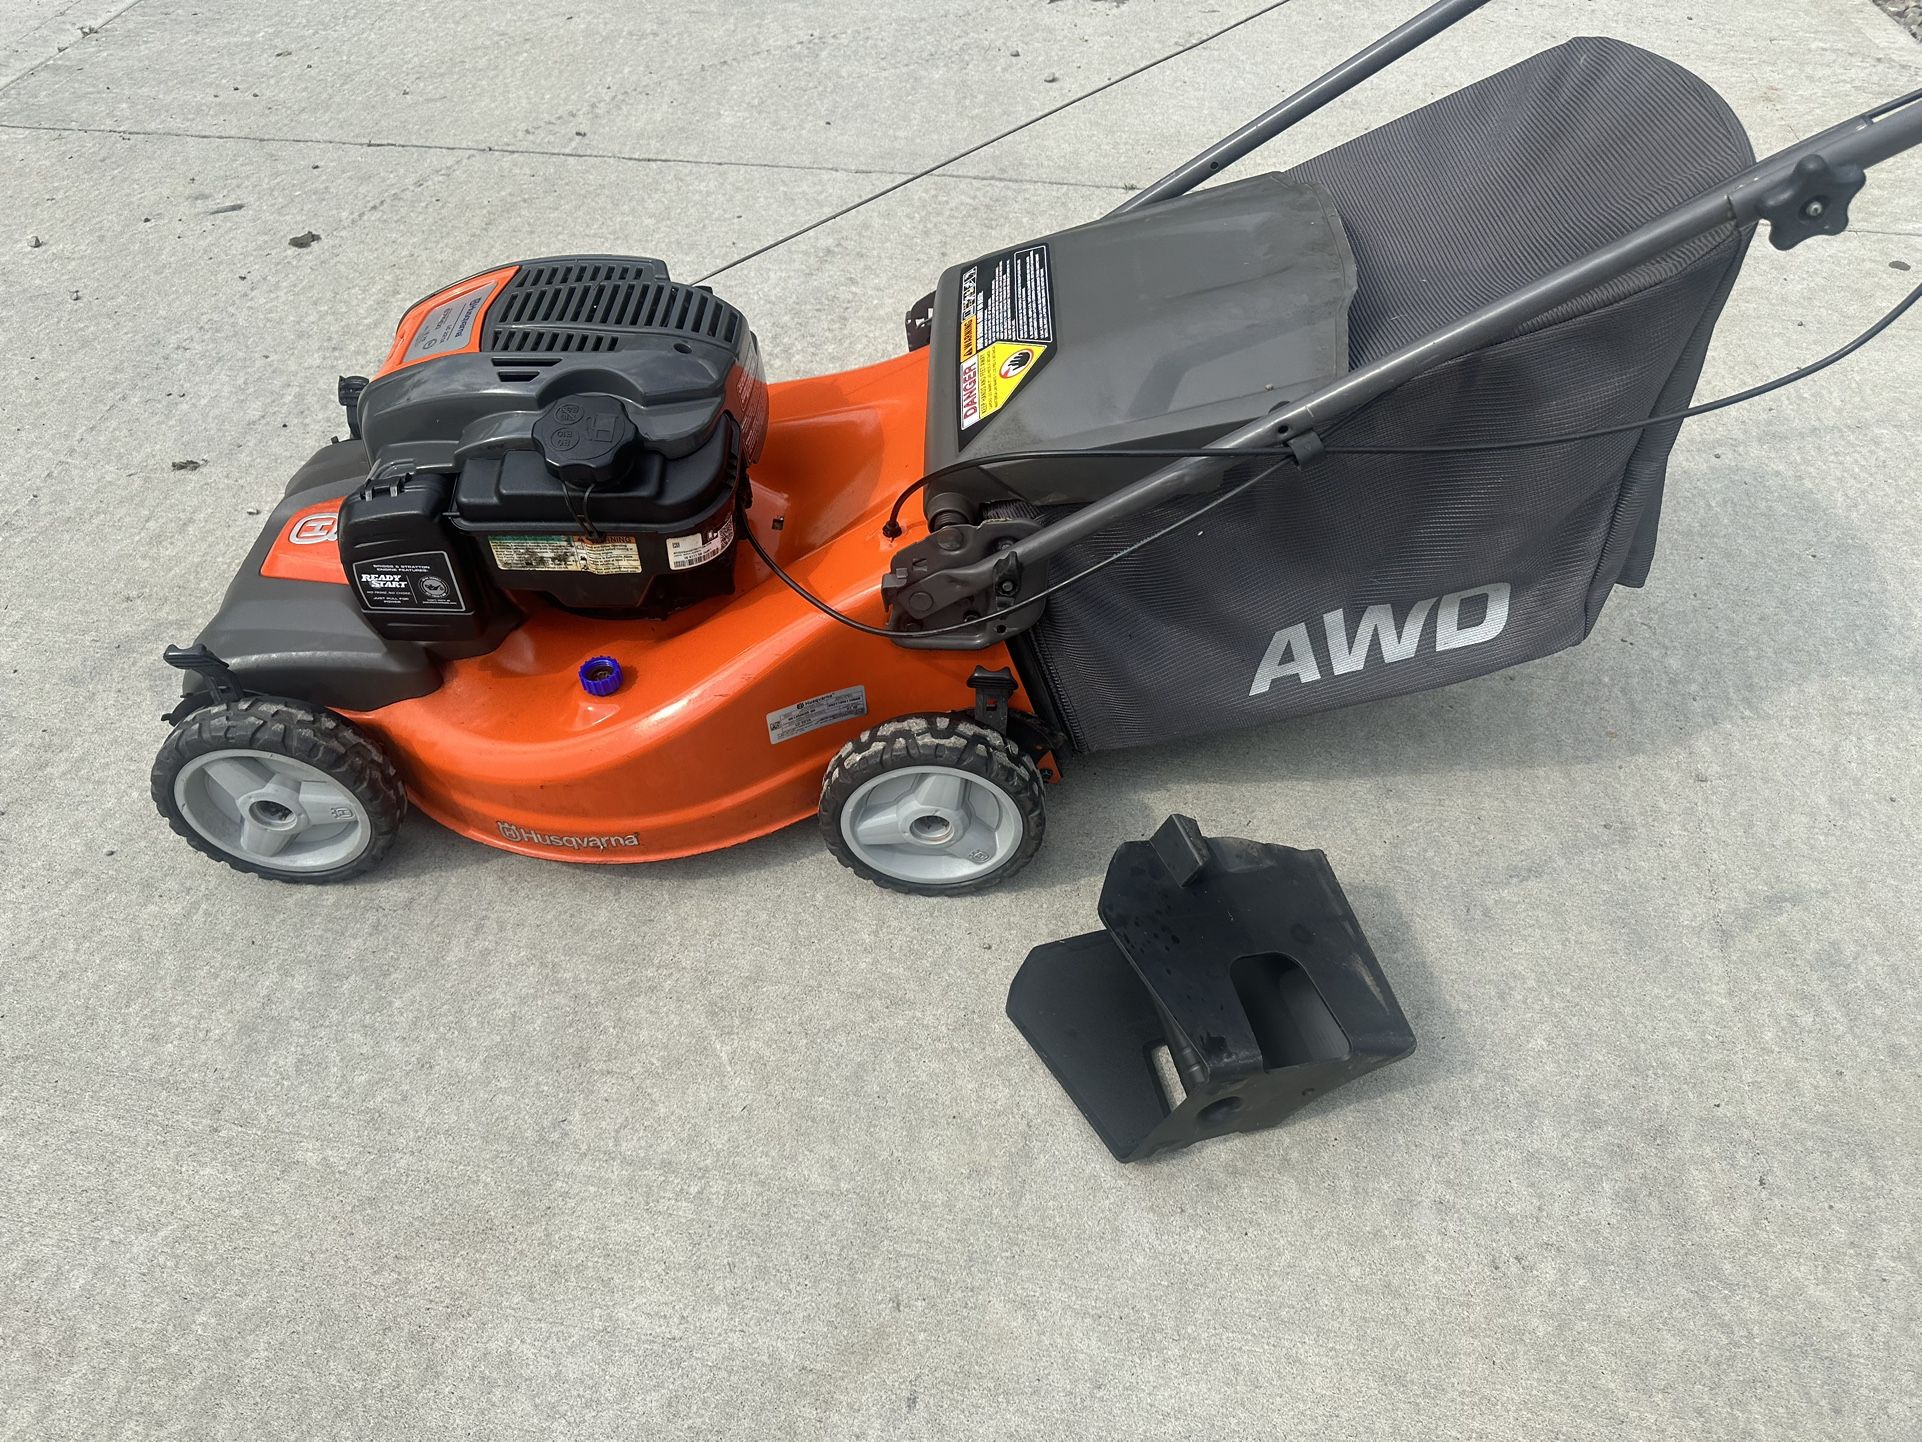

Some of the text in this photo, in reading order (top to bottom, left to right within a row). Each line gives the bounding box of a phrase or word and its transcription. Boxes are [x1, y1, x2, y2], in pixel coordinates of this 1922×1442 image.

[963, 319, 973, 347] WARNING
[963, 362, 978, 420] DANGER
[361, 574, 401, 582] READY
[1248, 582, 1512, 697] AWD
[519, 828, 640, 850] Husqvarna
